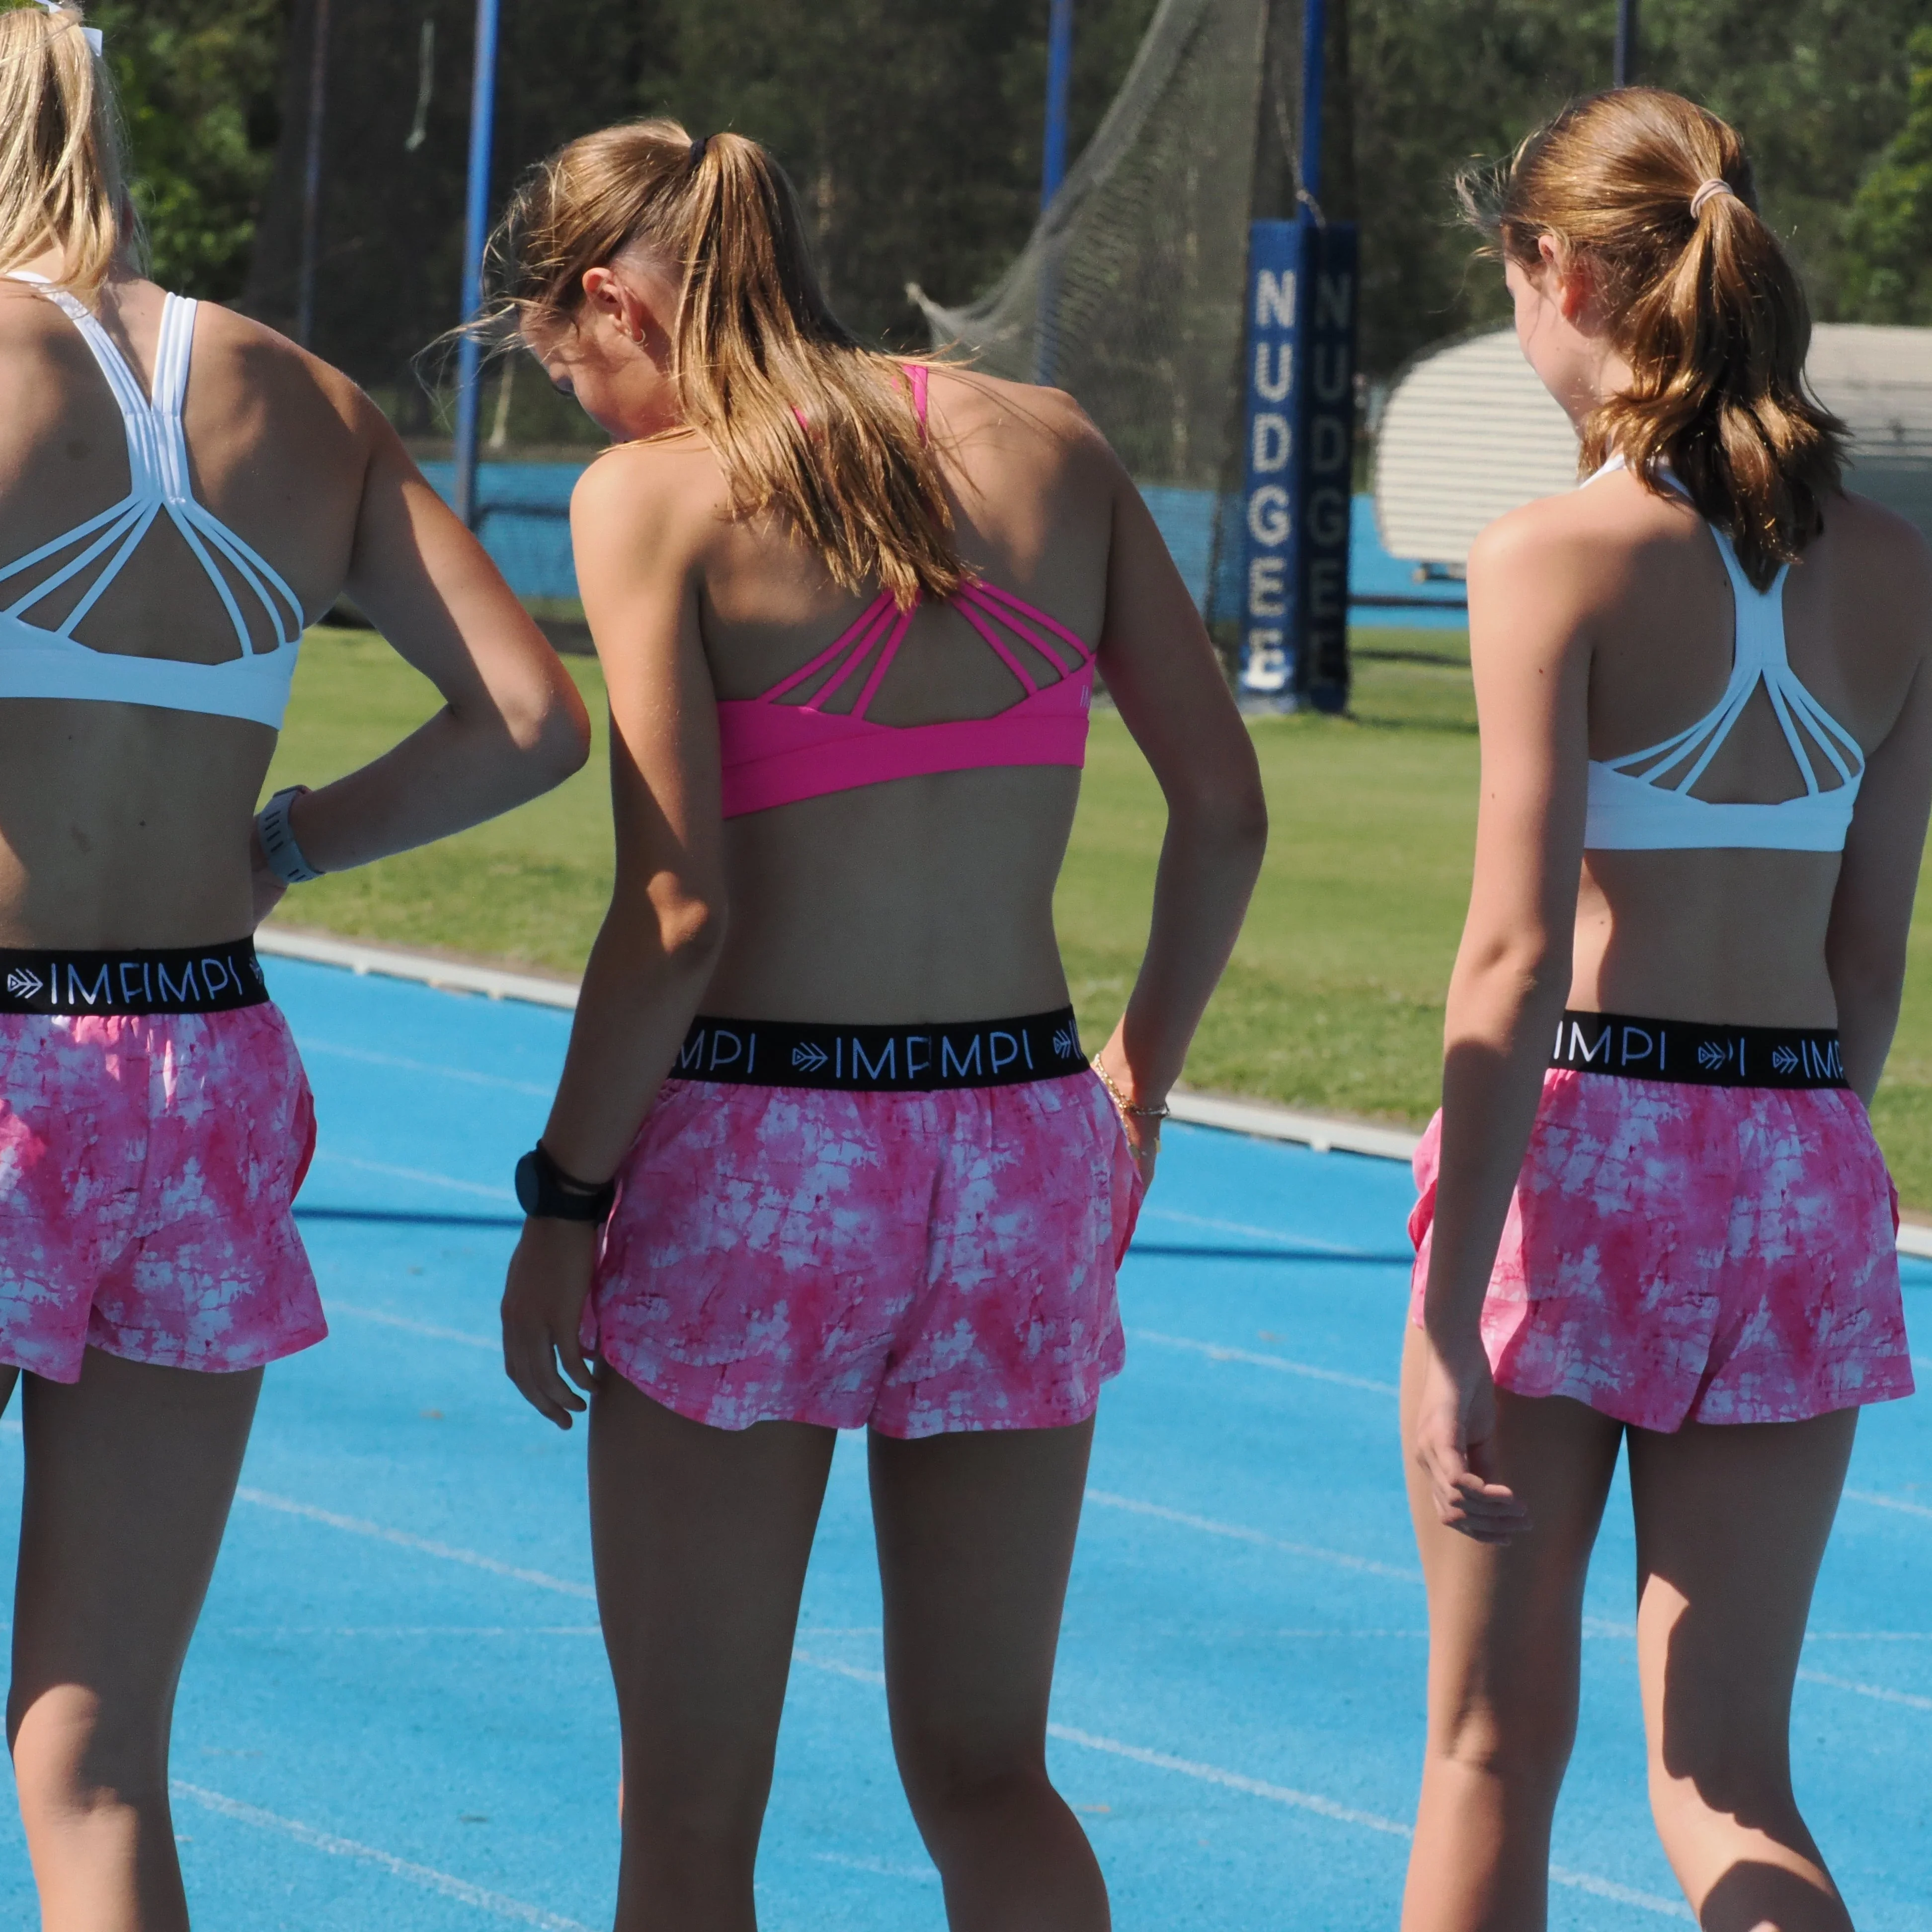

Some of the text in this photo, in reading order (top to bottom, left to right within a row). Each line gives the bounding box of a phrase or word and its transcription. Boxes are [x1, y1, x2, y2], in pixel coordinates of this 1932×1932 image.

[1247, 269, 1295, 689] NUDGEE
[1307, 272, 1351, 687] NUDGEE
[51, 963, 142, 1004] IMP
[673, 1029, 756, 1074] MPI
[836, 1037, 931, 1080] IMP
[928, 1029, 1034, 1077] MPI
[1553, 1020, 1666, 1071] IMPI
